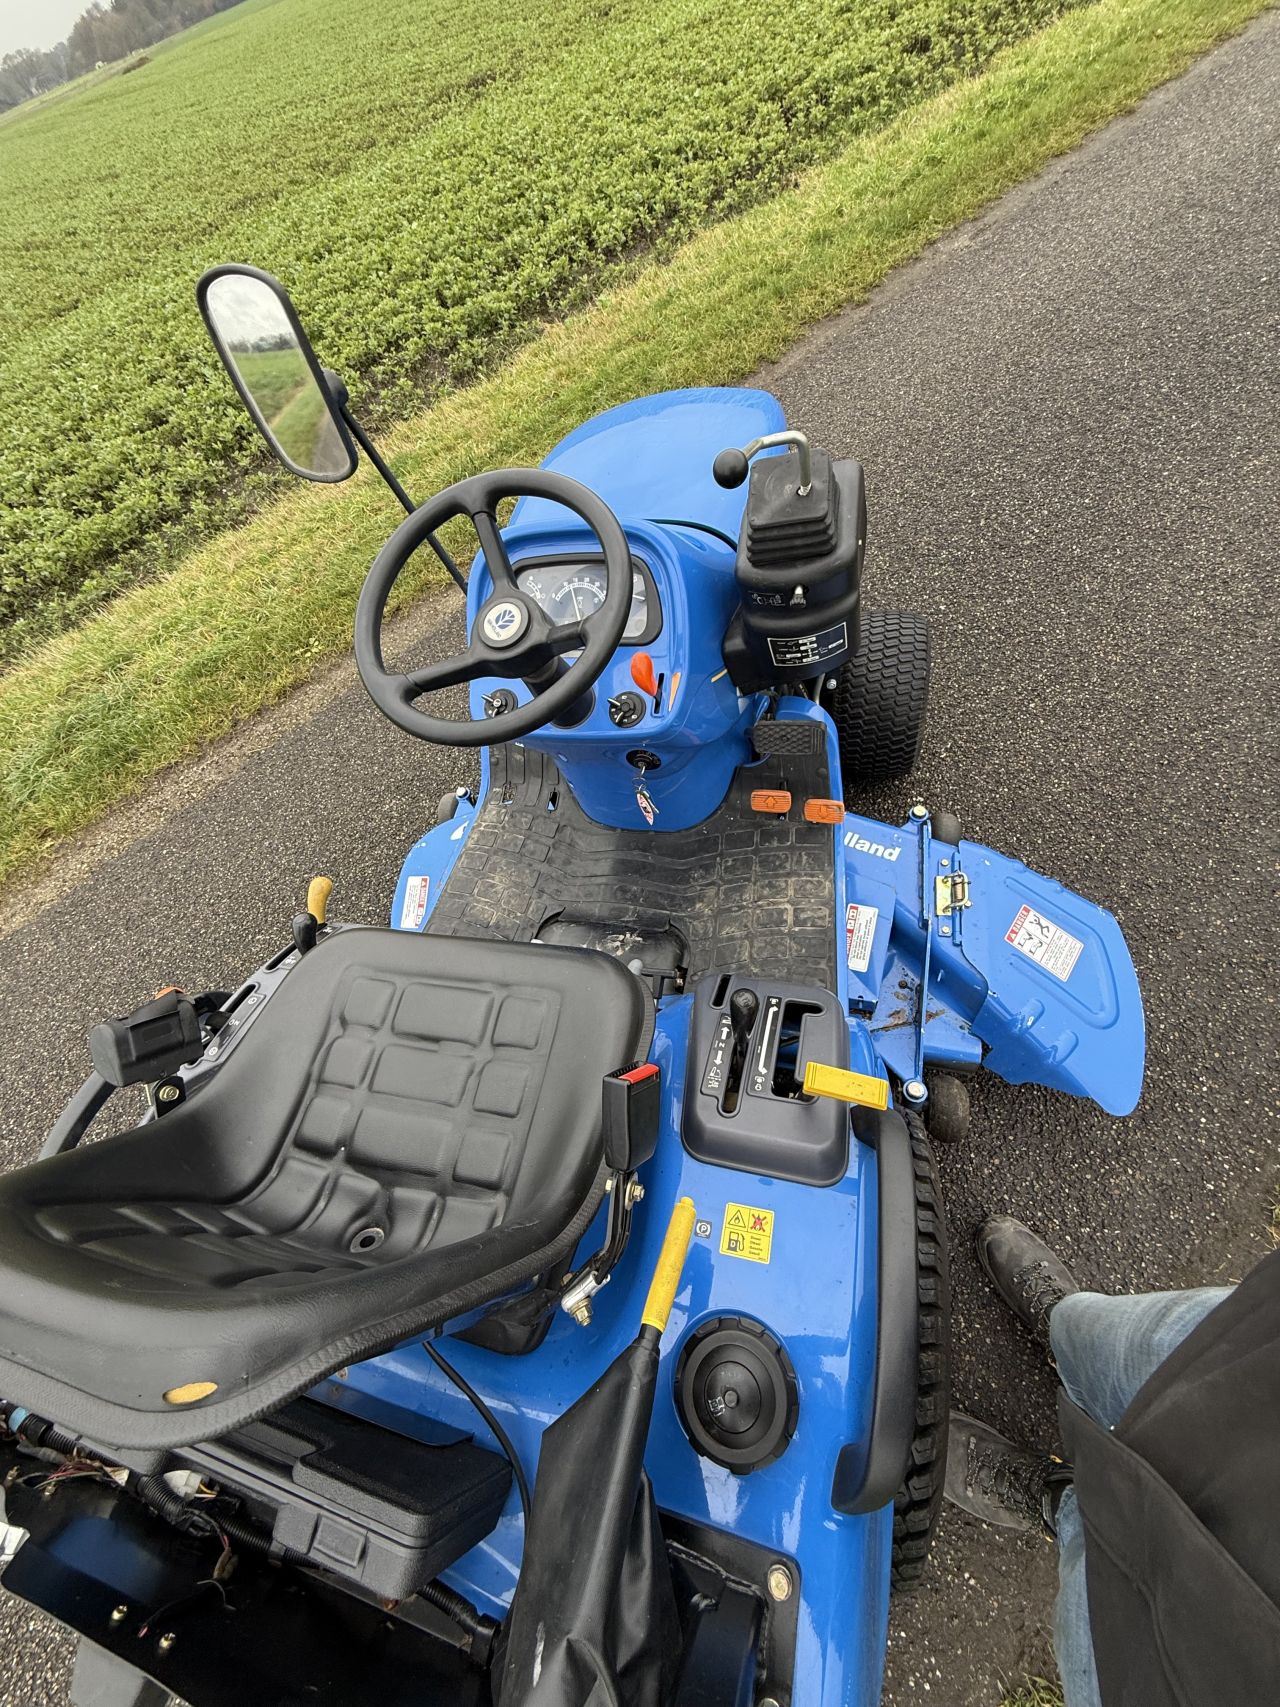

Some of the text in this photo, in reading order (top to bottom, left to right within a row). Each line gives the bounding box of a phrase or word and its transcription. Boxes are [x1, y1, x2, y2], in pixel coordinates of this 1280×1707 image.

[843, 831, 902, 862] lland
[1012, 910, 1028, 932] DANGER
[730, 1240, 736, 1248] D
